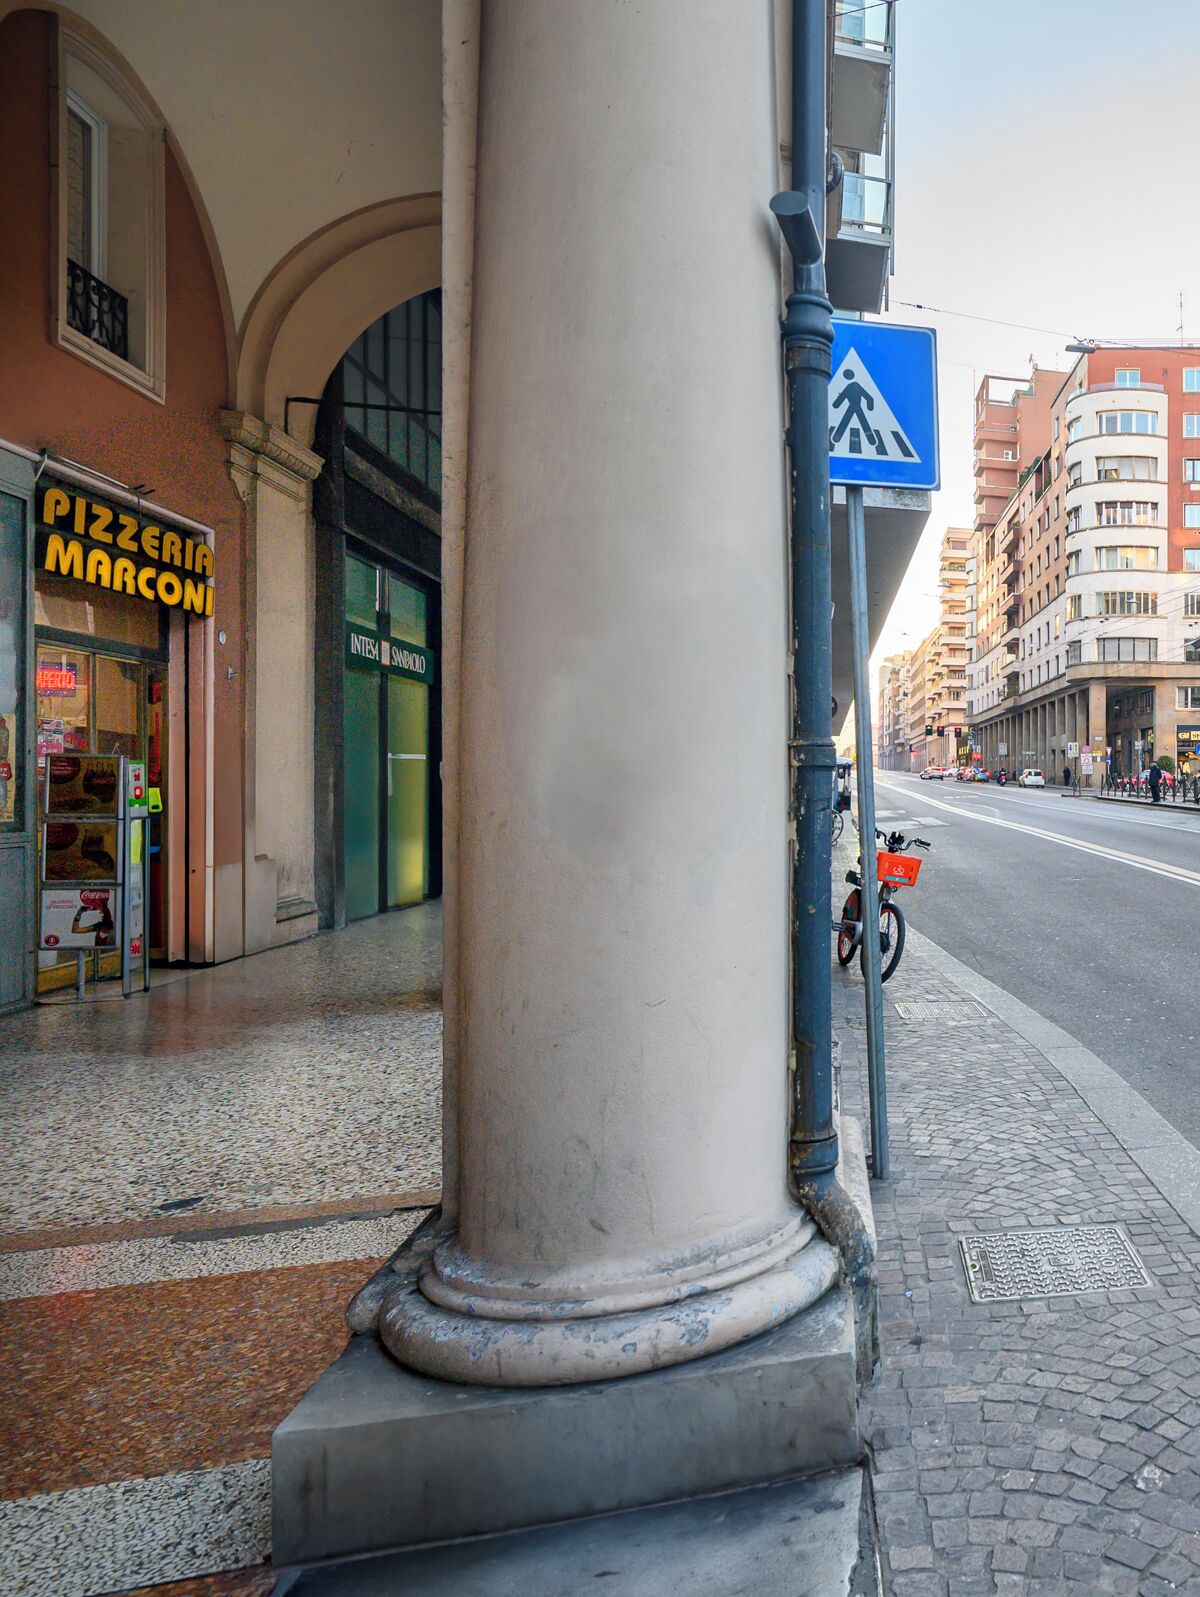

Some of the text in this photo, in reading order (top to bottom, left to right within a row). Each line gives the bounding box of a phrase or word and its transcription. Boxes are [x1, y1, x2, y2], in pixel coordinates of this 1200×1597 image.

[43, 488, 214, 577] PIZZERIA
[44, 533, 214, 617] MARCONI
[351, 632, 426, 674] INTESA SANPAOLO
